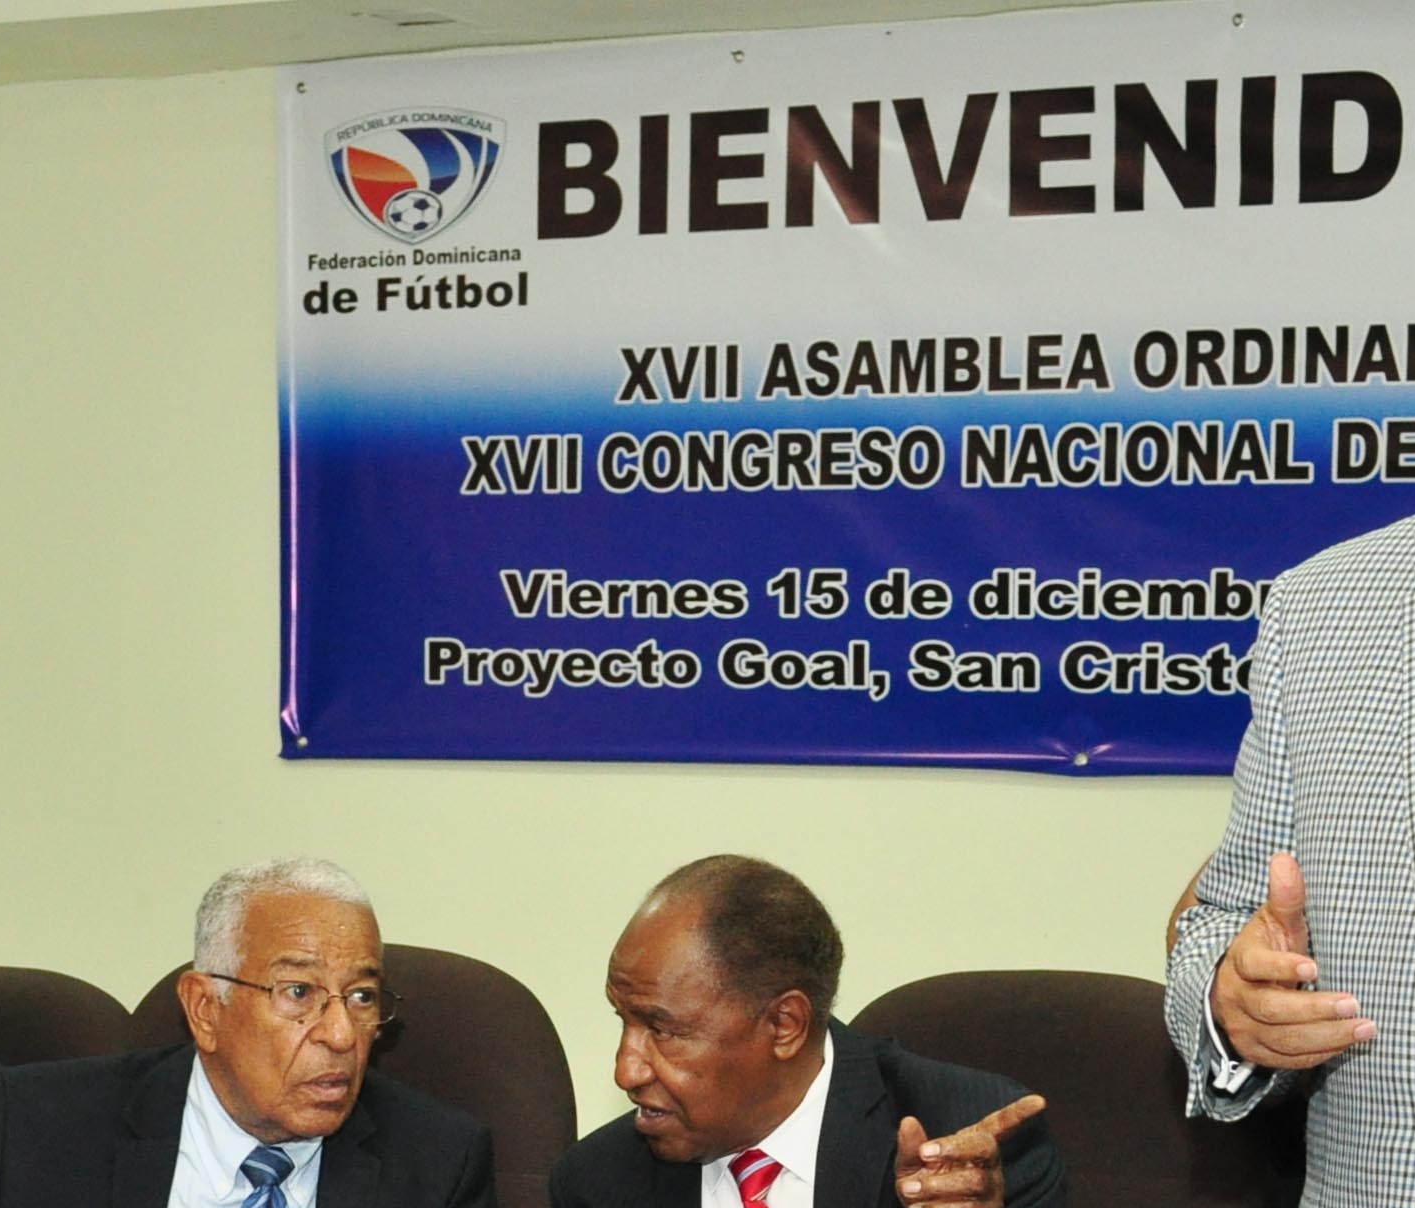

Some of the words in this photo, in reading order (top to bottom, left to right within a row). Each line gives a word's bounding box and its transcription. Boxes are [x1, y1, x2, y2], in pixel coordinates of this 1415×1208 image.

[411, 112, 493, 133] DOMINICANA
[307, 250, 407, 271] Federación
[412, 247, 523, 266] Dominicana
[302, 281, 359, 315] de
[376, 271, 528, 312] Fútbol
[618, 344, 739, 402] XVII
[759, 332, 1111, 398] ASAMBLEA
[464, 437, 579, 492] XVII
[600, 428, 941, 490] CONGRESO
[965, 422, 1310, 485] NACIONAL
[504, 572, 745, 616] Viernes
[770, 571, 845, 616] 15
[868, 571, 949, 617] de
[428, 640, 698, 695] Proyecto
[721, 641, 887, 698] Goal,
[911, 643, 1037, 689] San
